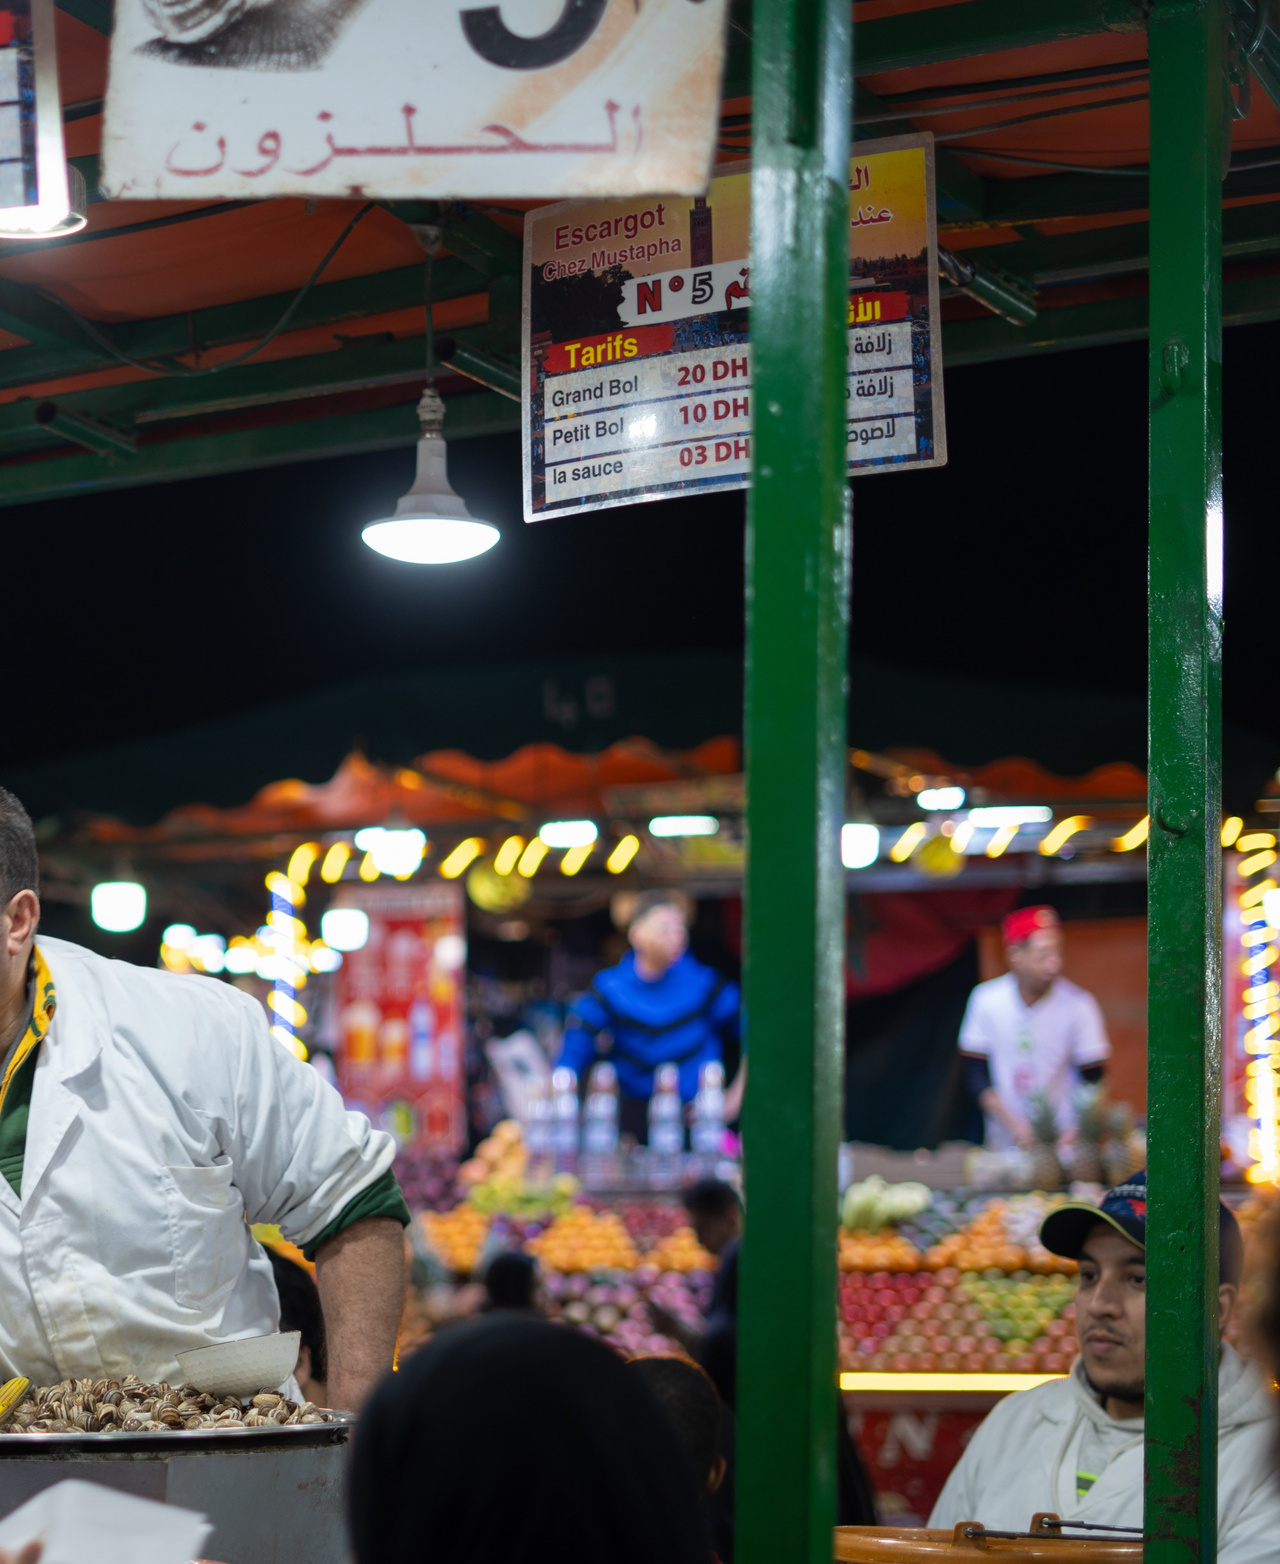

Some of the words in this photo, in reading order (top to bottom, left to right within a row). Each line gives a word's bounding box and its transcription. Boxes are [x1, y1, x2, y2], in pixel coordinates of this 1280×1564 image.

[165, 99, 644, 178] الحلزون
[554, 202, 666, 251] Escargot
[851, 205, 893, 228] عند
[543, 258, 587, 282] Chez
[591, 237, 682, 270] Mustapha
[691, 271, 714, 305] 5
[564, 334, 638, 368] Tarifs
[854, 332, 892, 355] زلافة
[677, 364, 706, 387] 20
[712, 357, 748, 381] DH
[856, 375, 893, 398] زلافة
[552, 382, 604, 408] Grand
[609, 375, 638, 396] Bol
[679, 403, 707, 425] 10
[713, 397, 749, 421] DH
[552, 425, 590, 446] Petit
[596, 417, 624, 437] Bol
[679, 445, 708, 467] 03
[715, 438, 751, 462] DH
[553, 468, 567, 485] la
[572, 460, 624, 481] sauce
